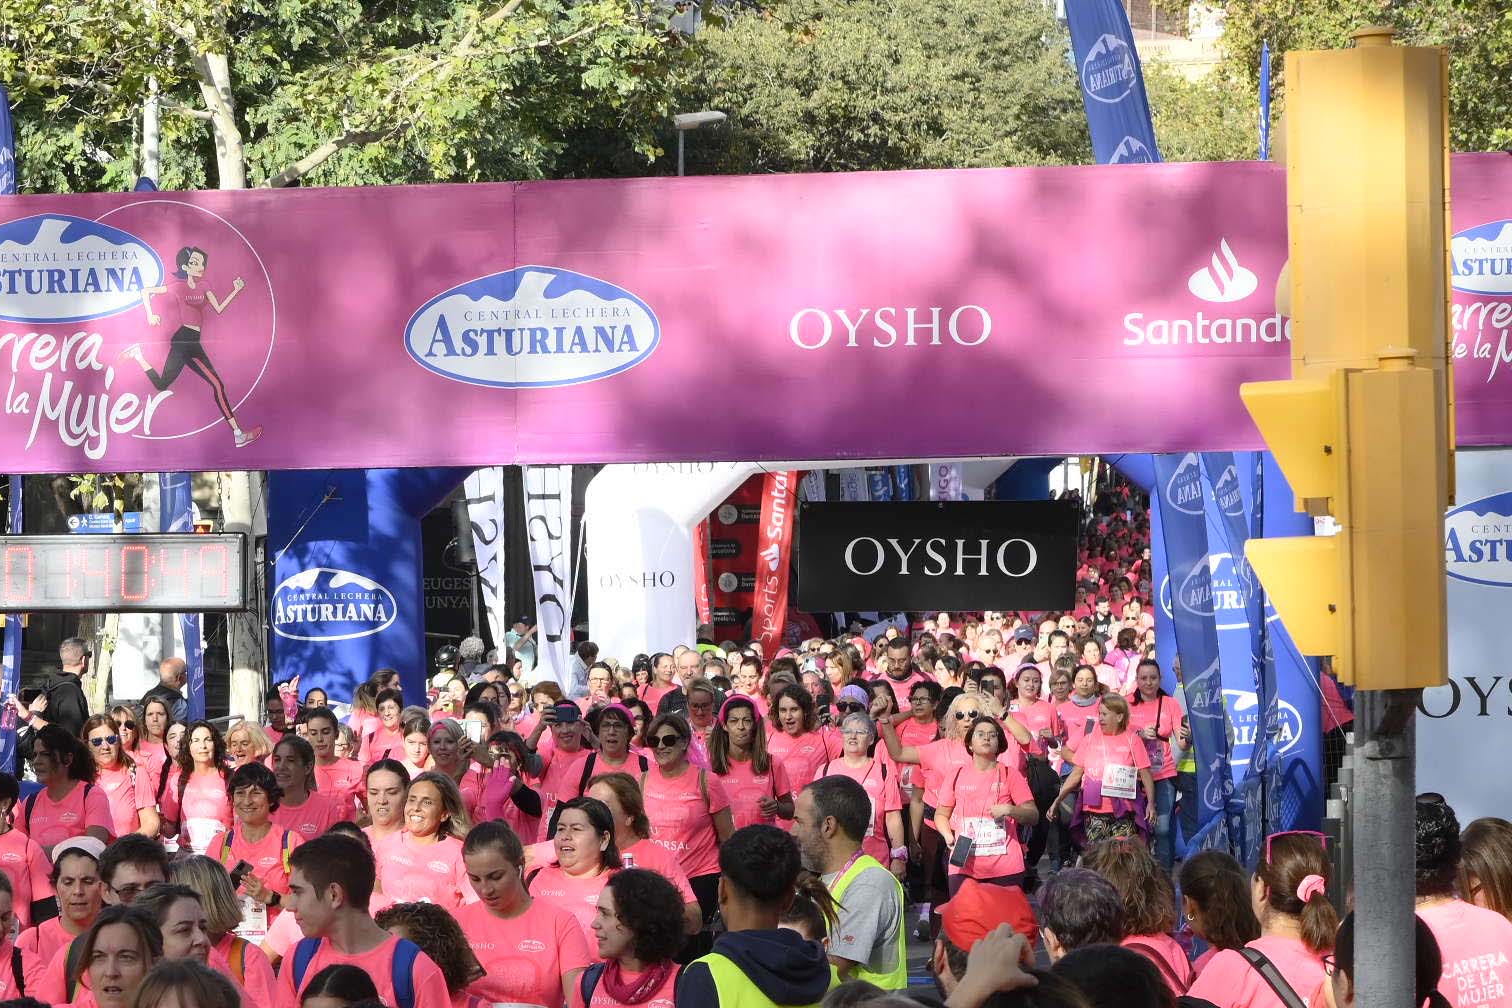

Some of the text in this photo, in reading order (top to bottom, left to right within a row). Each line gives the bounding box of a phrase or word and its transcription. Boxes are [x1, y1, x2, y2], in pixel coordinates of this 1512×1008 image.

[67, 250, 139, 261] LECHERA
[464, 306, 632, 322] CENTRAL LECHERA
[425, 313, 640, 359] ASTURIANA
[789, 305, 992, 350] OYSHO
[5, 374, 30, 415] la
[24, 367, 174, 461] Mujer
[845, 536, 1038, 578] OYSHO
[287, 593, 328, 601] CENTRAL
[274, 600, 388, 625] ASTURIANA
[1442, 951, 1508, 978] CARRERA
[1457, 970, 1500, 991] DE LA
[1457, 983, 1505, 1008] MUJER
